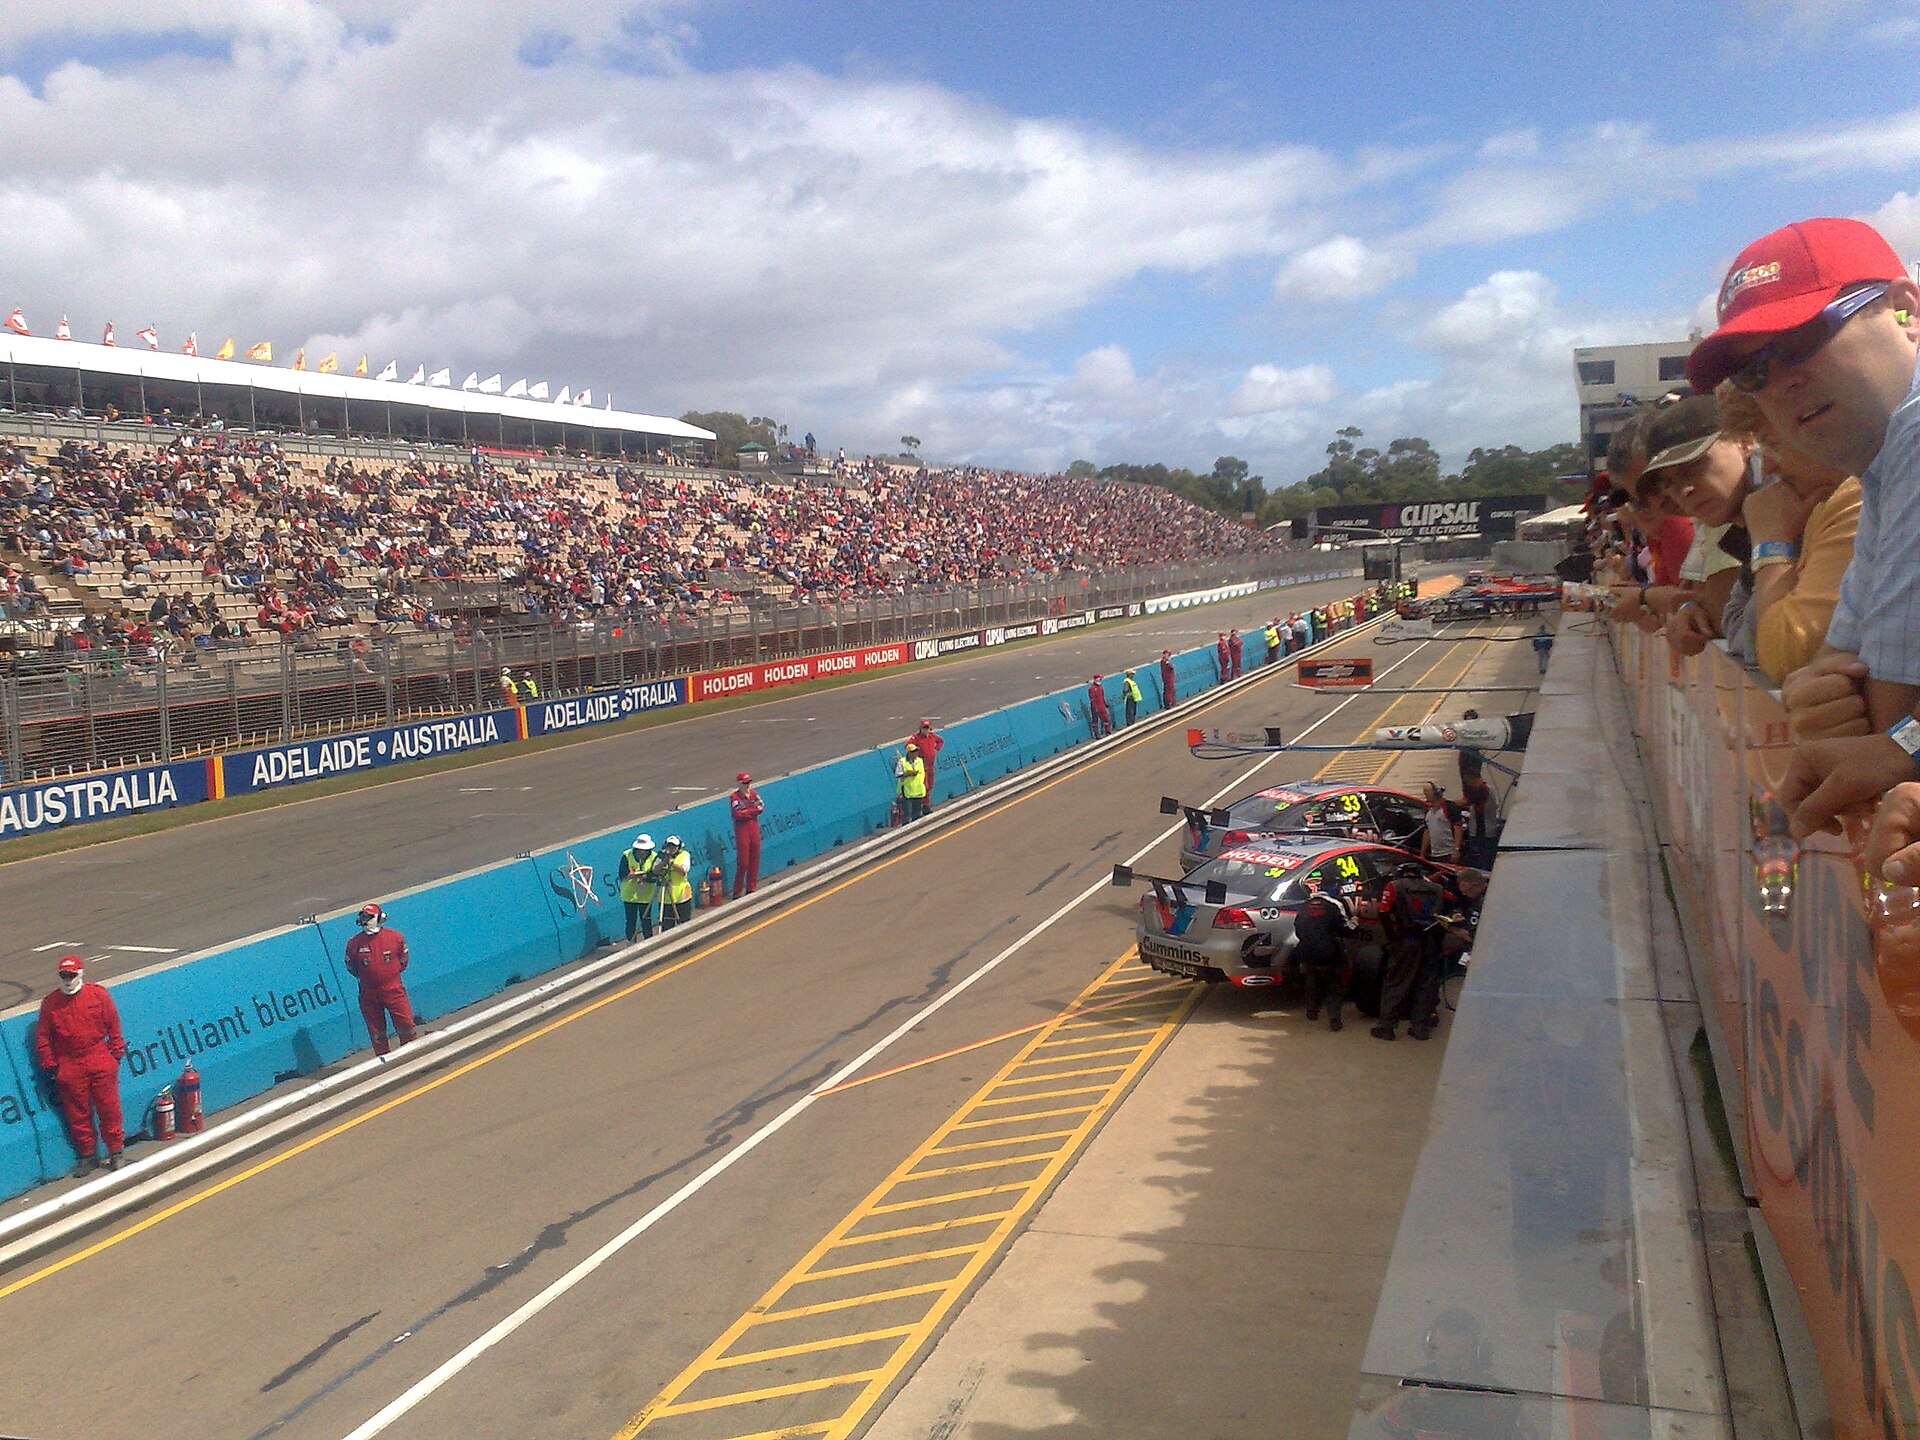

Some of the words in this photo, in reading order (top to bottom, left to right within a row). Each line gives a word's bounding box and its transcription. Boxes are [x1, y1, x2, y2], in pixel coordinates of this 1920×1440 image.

[1400, 502, 1481, 527] CLIPSAL
[1381, 527, 1414, 538] LIVING
[1418, 523, 1480, 537] ELECTRICAL
[817, 655, 857, 673] HOLDEN
[864, 648, 900, 666] HOLDEN
[702, 671, 754, 696] HOLDEN
[763, 663, 809, 684] HOLDEN
[543, 694, 620, 732] ADELAIDE
[251, 736, 372, 788] ADELAIDE
[390, 715, 499, 761] AUSTRALIA
[0, 770, 178, 834] AUSTRALIA
[1340, 794, 1362, 812] 33
[1223, 850, 1297, 868] HOLDEN
[1335, 855, 1360, 878] 34
[1263, 867, 1287, 879] 34
[1142, 935, 1202, 963] Cummins
[125, 1005, 252, 1078] brilliant
[256, 973, 339, 1029] blend.
